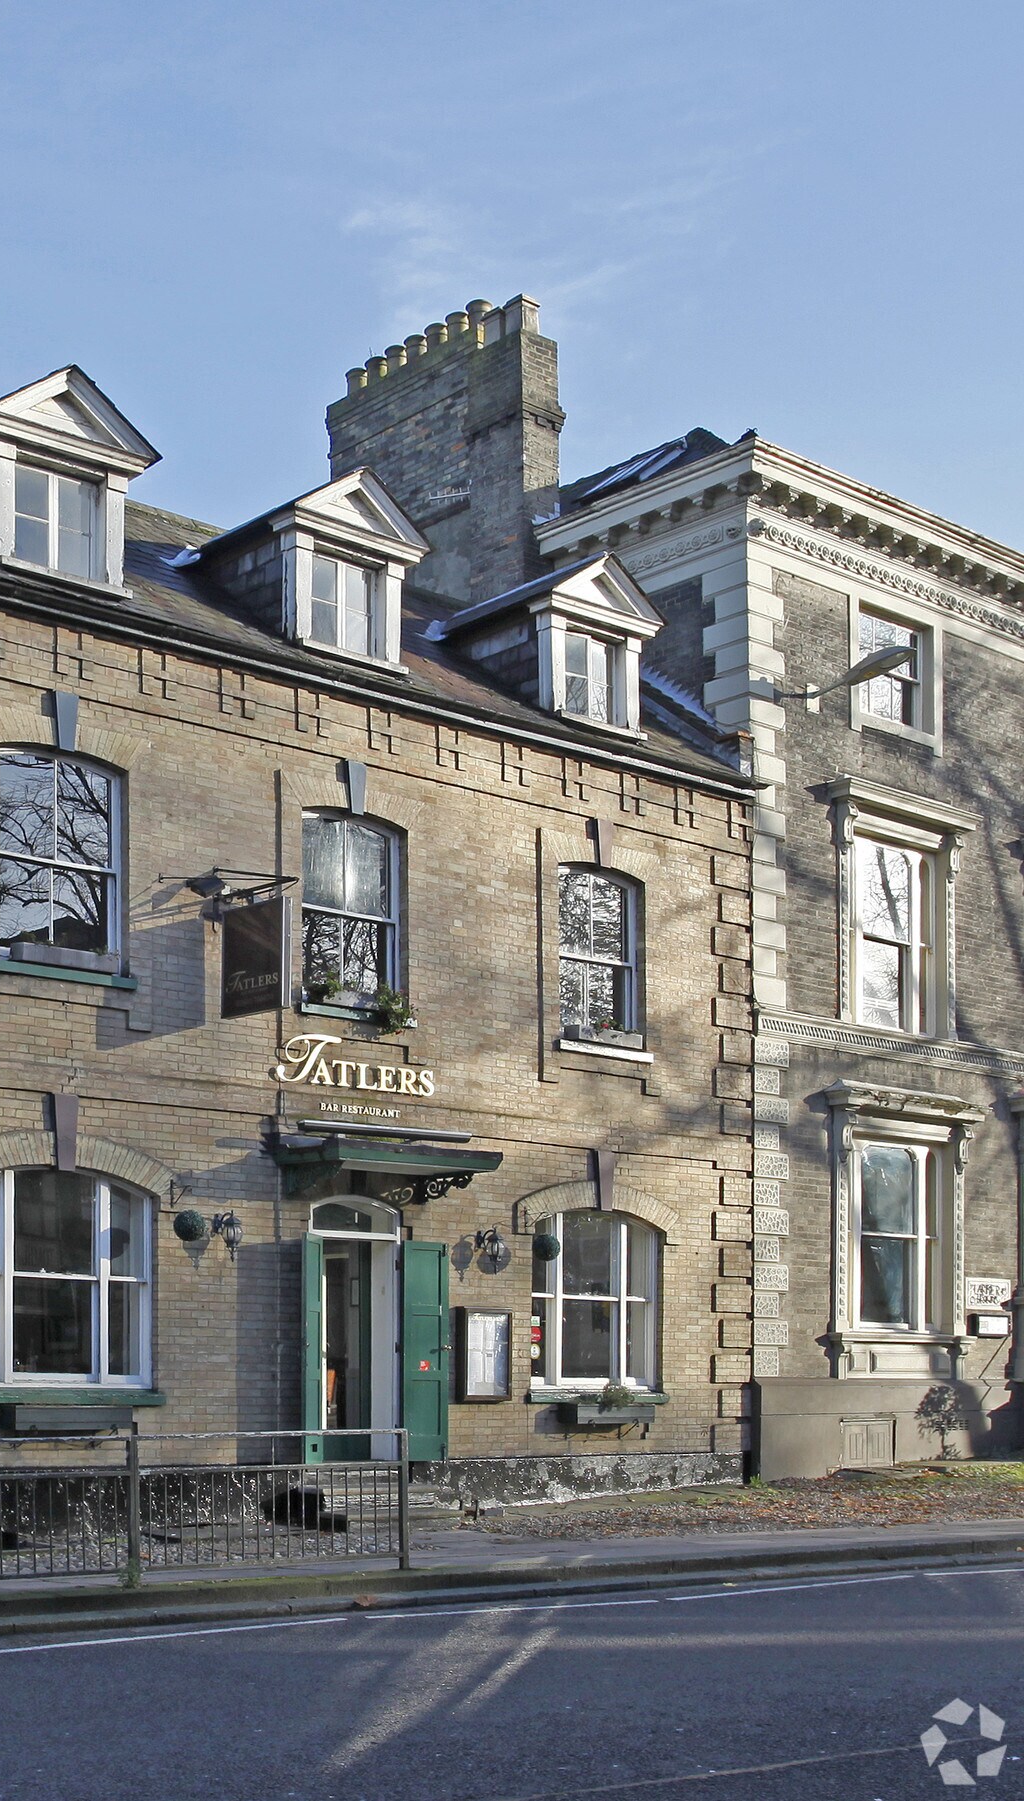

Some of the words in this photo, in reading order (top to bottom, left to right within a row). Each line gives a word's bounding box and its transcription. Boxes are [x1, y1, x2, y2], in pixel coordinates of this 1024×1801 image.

[225, 970, 279, 993] TATLERS
[276, 1033, 435, 1097] TATLERS
[320, 1102, 339, 1112] BAR
[342, 1104, 401, 1118] RESTAURANT
